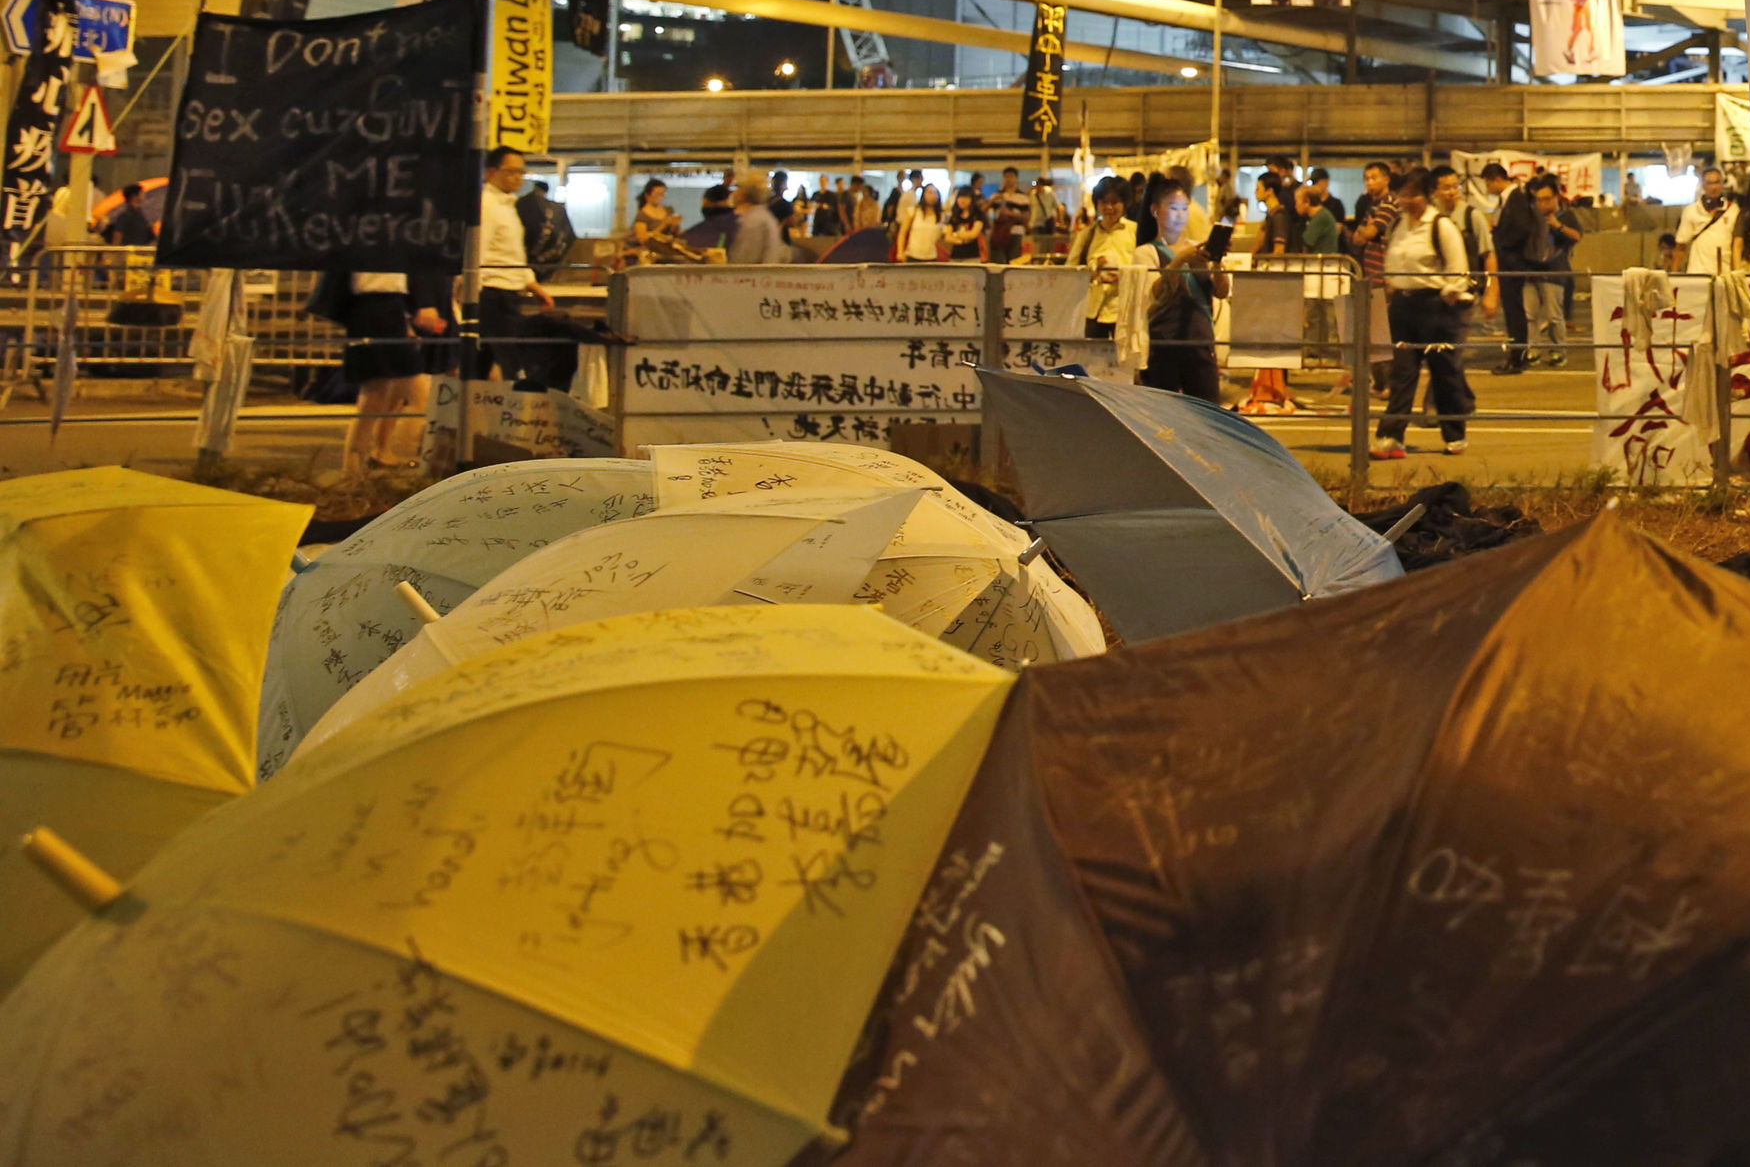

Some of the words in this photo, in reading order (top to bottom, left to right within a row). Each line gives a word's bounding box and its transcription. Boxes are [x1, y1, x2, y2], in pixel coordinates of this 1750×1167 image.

[496, 14, 530, 144] Taiwan
[181, 99, 262, 142] sex
[326, 154, 420, 199] ME
